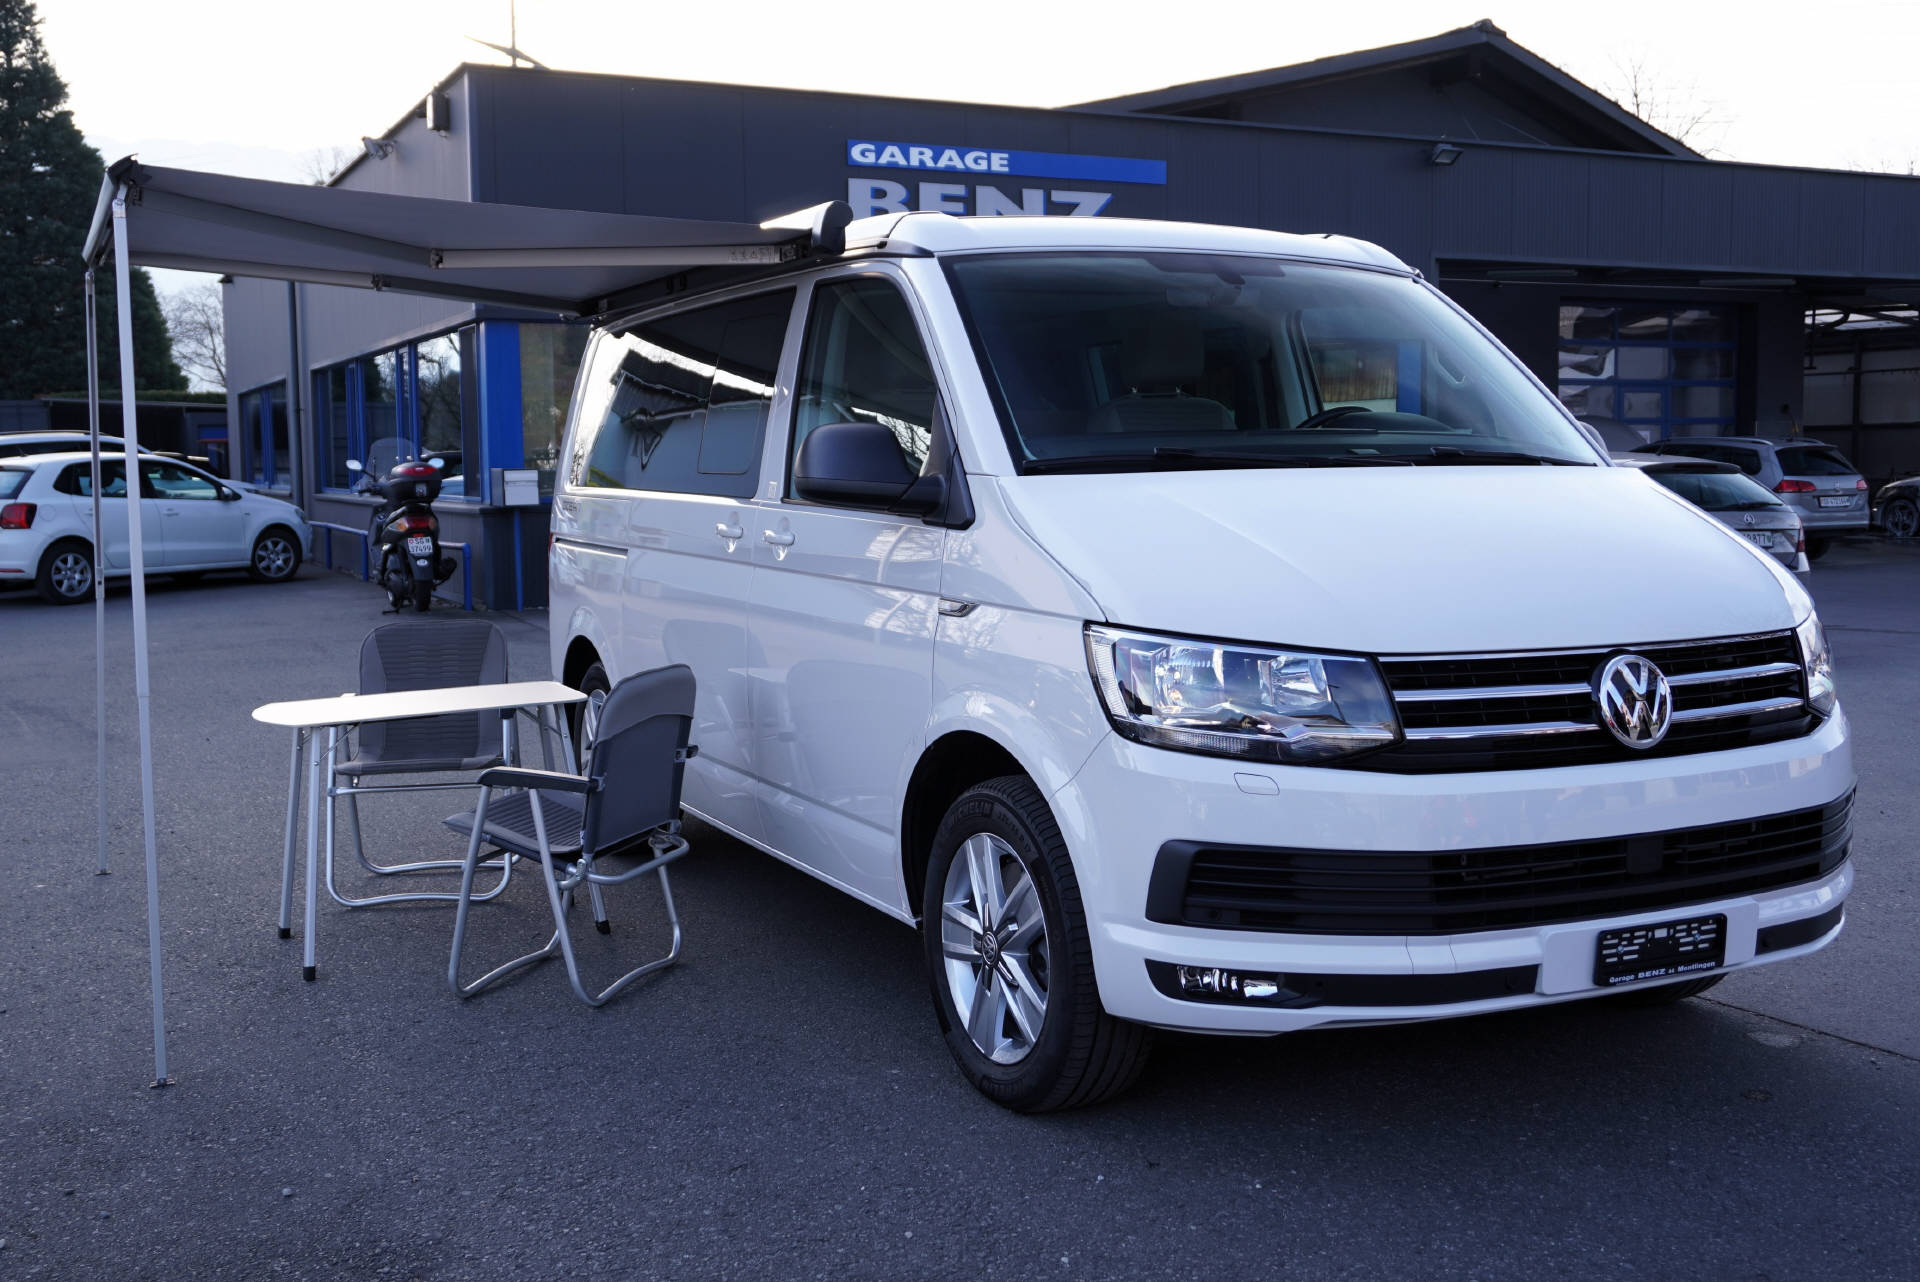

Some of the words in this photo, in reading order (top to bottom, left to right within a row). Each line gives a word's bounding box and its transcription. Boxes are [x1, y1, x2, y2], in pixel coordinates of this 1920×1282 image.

[851, 143, 1009, 172] GARAGE
[1609, 974, 1635, 983] Garage
[1637, 968, 1666, 978] BENZ
